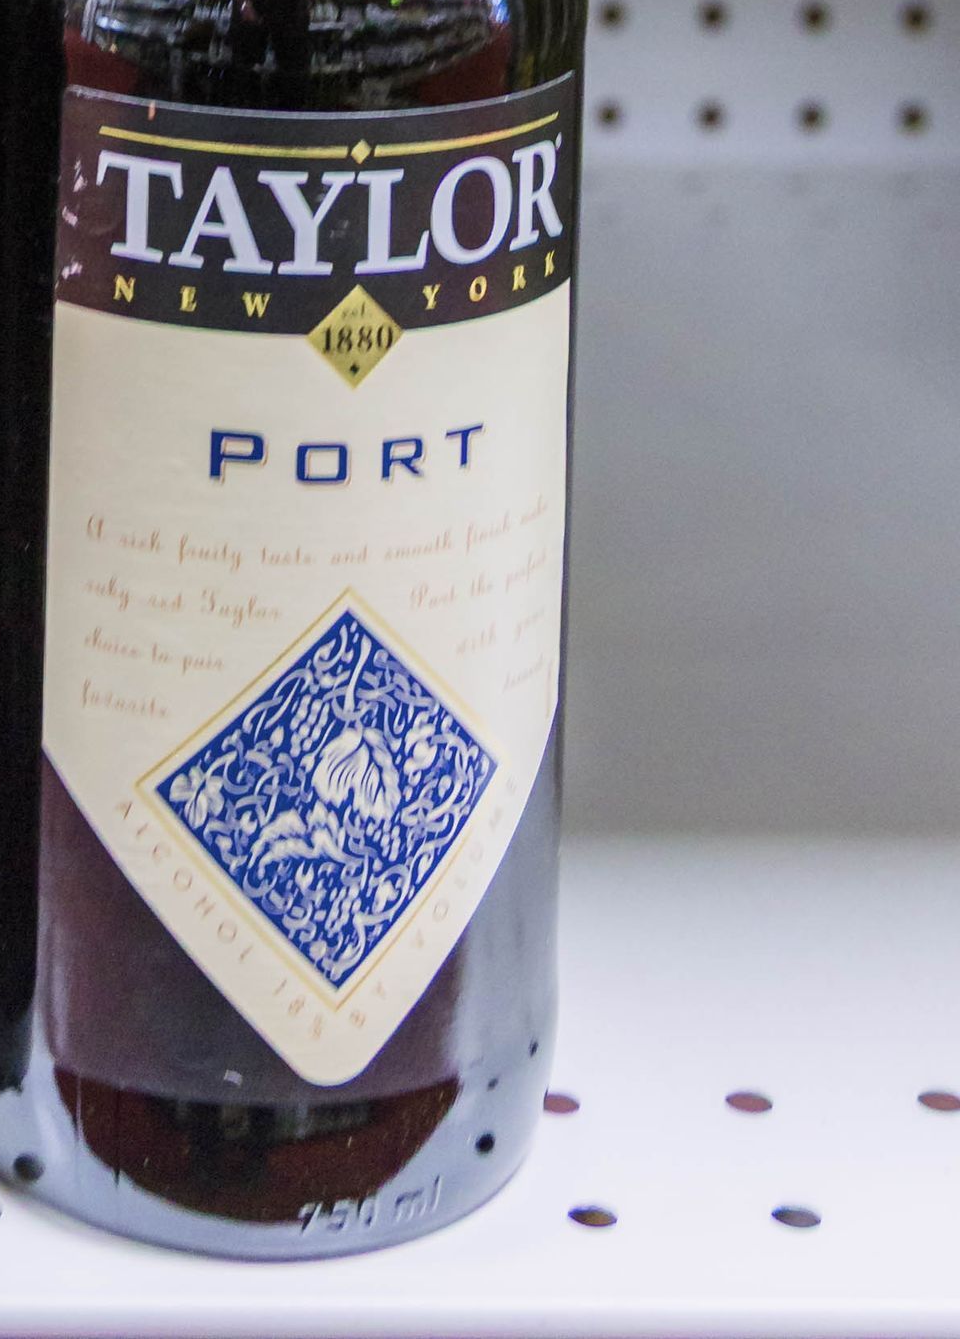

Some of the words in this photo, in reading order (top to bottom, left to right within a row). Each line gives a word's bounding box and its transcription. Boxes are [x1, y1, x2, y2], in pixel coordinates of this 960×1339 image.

[96, 140, 563, 275] TAYLOR
[112, 276, 273, 319] NEW
[423, 251, 555, 311] YORK
[324, 324, 393, 354] 1880
[208, 423, 485, 485] PORT
[330, 542, 370, 566] and
